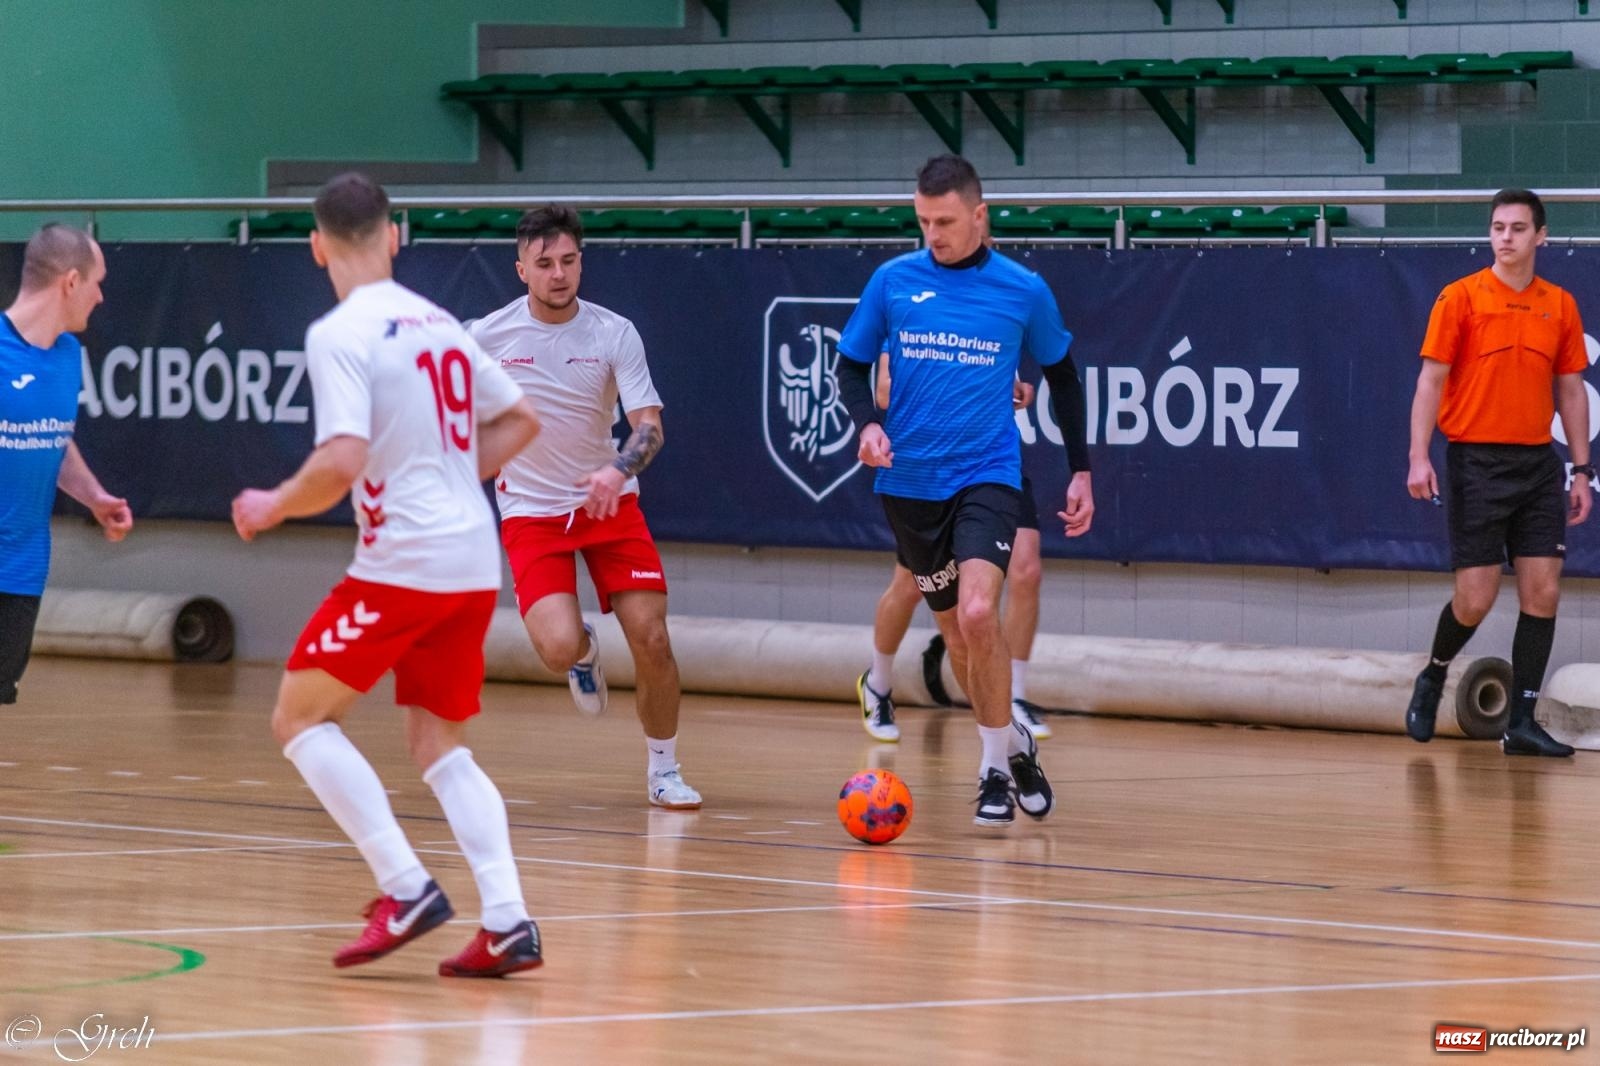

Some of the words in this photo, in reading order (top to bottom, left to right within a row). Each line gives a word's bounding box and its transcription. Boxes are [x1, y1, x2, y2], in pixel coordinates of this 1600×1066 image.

[899, 330, 1001, 353] Marek&Dariusz
[902, 347, 954, 362] Metallbau
[957, 352, 995, 366] GmbH
[416, 347, 472, 453] 19
